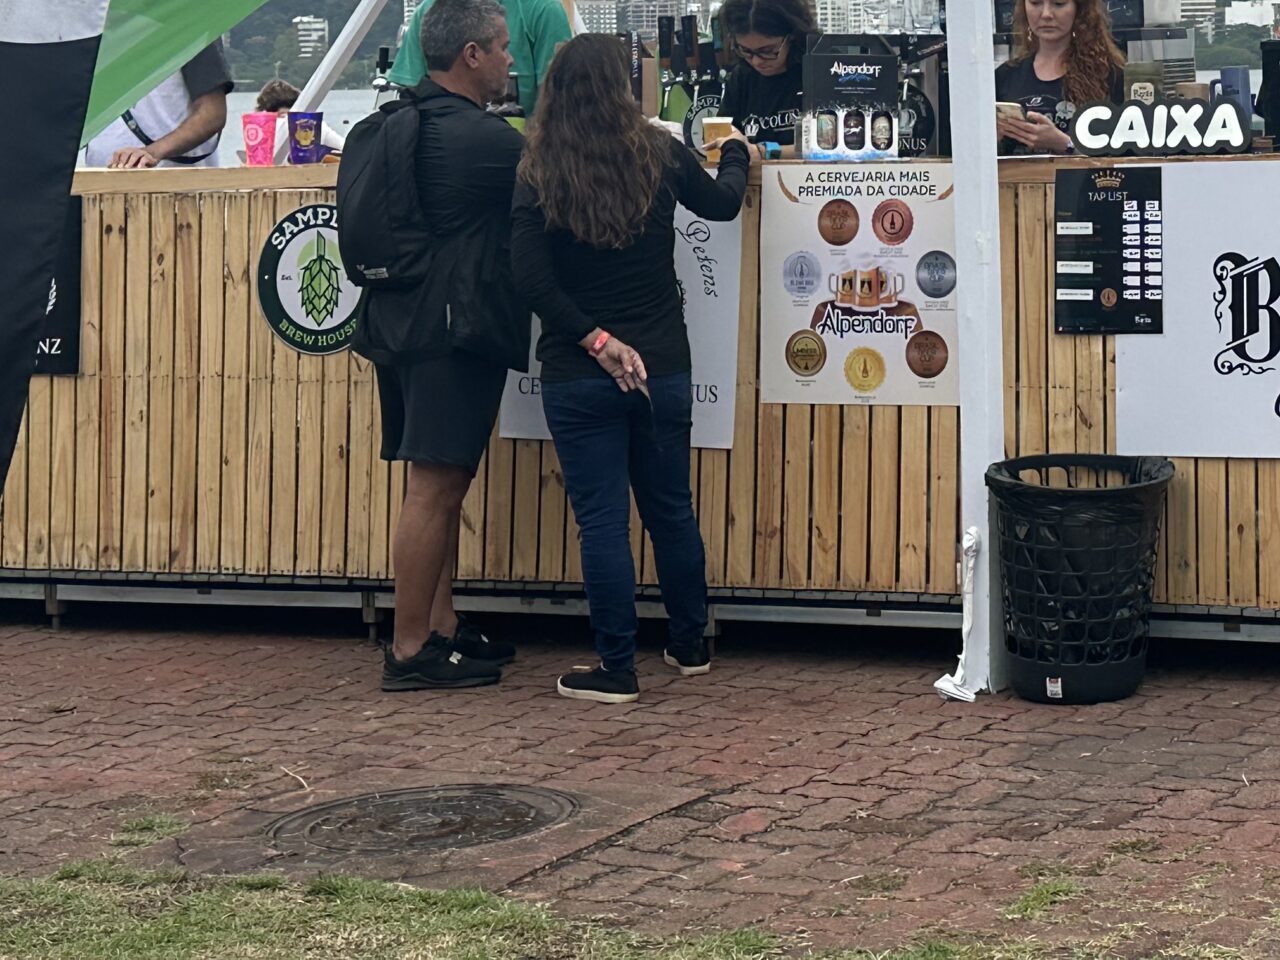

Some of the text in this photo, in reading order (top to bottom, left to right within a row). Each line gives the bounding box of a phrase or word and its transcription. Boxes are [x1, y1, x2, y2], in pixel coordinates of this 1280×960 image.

[830, 61, 882, 77] Alpendorf
[1075, 103, 1244, 149] CAIXA
[805, 171, 930, 183] A CERVEJARIA MAIS
[798, 184, 937, 197] PREMIADA DA CIDADE
[1108, 192, 1128, 200] LIST
[271, 208, 338, 250] SAMPL
[819, 305, 915, 340] Alpendorf
[279, 319, 315, 345] BREW
[37, 338, 61, 355] NZ
